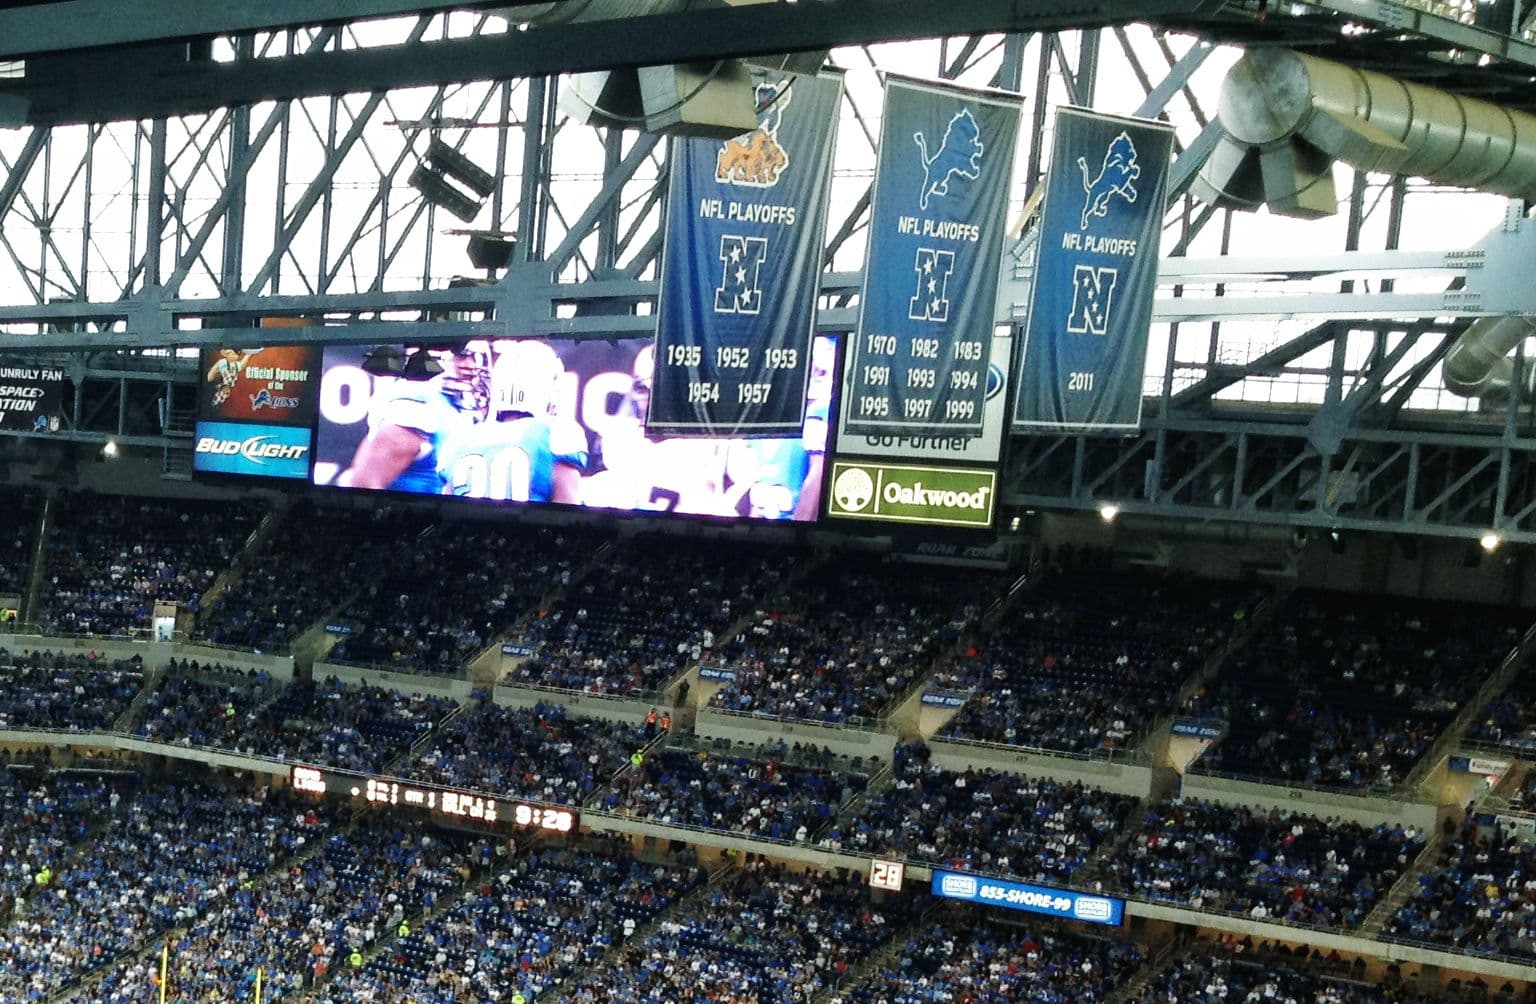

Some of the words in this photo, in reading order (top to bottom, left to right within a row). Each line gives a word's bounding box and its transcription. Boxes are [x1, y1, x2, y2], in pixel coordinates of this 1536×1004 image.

[700, 198, 725, 219] NFL
[728, 202, 795, 225] PLAYOFFS
[898, 216, 921, 235] NFL
[923, 219, 980, 242] PLAYOFFS
[1062, 232, 1082, 250] NFL
[1084, 235, 1137, 257] PLAYOFFS
[668, 344, 701, 367] 1935
[717, 347, 749, 368] 1952
[764, 348, 797, 369] 1953
[868, 334, 896, 355] 1970
[911, 338, 939, 358] 1982
[954, 341, 982, 360] 1983
[0, 368, 40, 380] UNRULY
[41, 370, 63, 381] FAN
[275, 368, 308, 381] Sponsor
[863, 366, 890, 385] 1991
[907, 368, 935, 388] 1993
[951, 371, 978, 389] 1994
[1068, 372, 1094, 391] 2011
[688, 382, 720, 403] 1954
[738, 383, 771, 404] 1957
[860, 396, 889, 416] 1995
[904, 398, 932, 418] 1997
[946, 400, 974, 419] 1999
[196, 437, 241, 456] BUD
[246, 442, 309, 459] LIGHT
[884, 482, 985, 510] Oakwood
[874, 863, 901, 888] 28
[980, 885, 1071, 911] 855-SHORE-99
